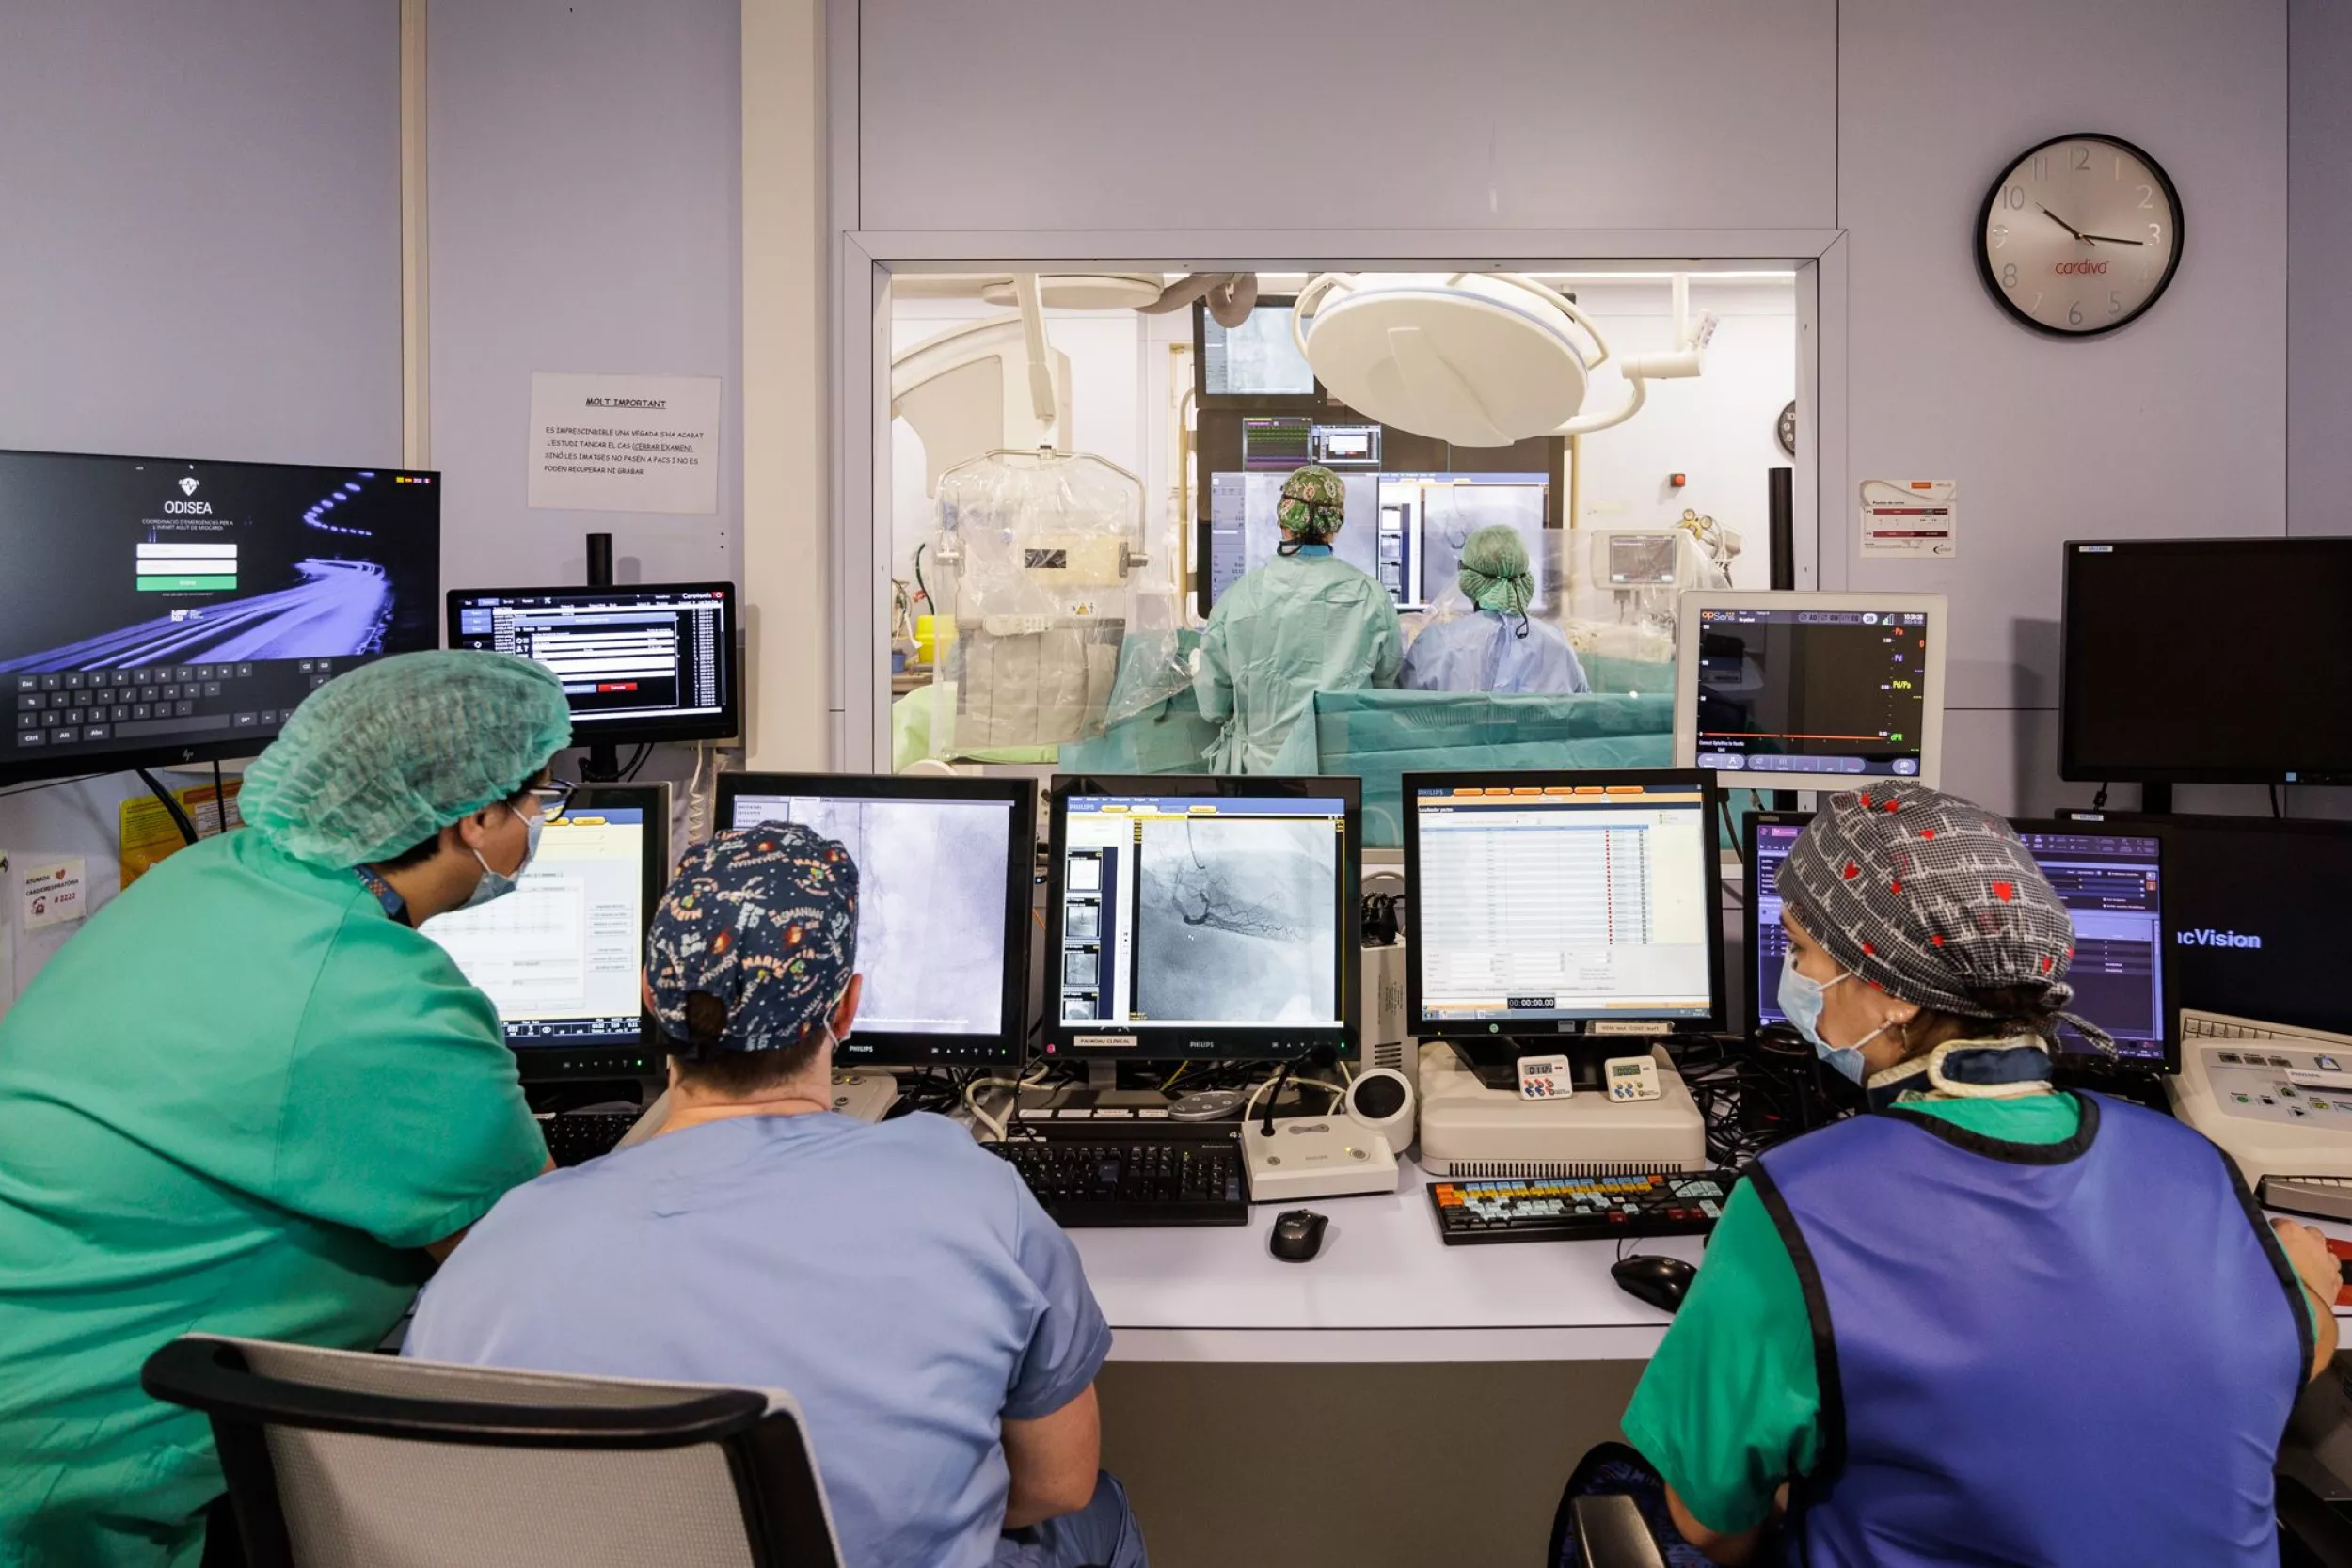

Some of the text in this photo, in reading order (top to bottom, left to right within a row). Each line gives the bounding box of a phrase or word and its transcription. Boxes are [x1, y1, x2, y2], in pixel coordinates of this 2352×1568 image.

[2069, 147, 2091, 171] 12
[2032, 156, 2049, 182] 11
[2002, 185, 2026, 211] 10
[2137, 184, 2154, 209] 2
[2147, 223, 2162, 246] 3
[2002, 262, 2018, 288] 8
[2055, 259, 2108, 275] cardiva
[2029, 291, 2044, 317] 7
[2107, 291, 2122, 315] 5
[2068, 301, 2084, 325] 6
[613, 398, 667, 408] IMPORTANT
[557, 427, 614, 436] IMPRESCINDIBLE
[624, 454, 646, 463] PASEN
[568, 466, 606, 474] RECUPERAR
[164, 500, 213, 515] ODISEA
[24, 734, 39, 742] Ctrl
[26, 875, 50, 884] ATURADA
[849, 1044, 873, 1053] PHILIPS
